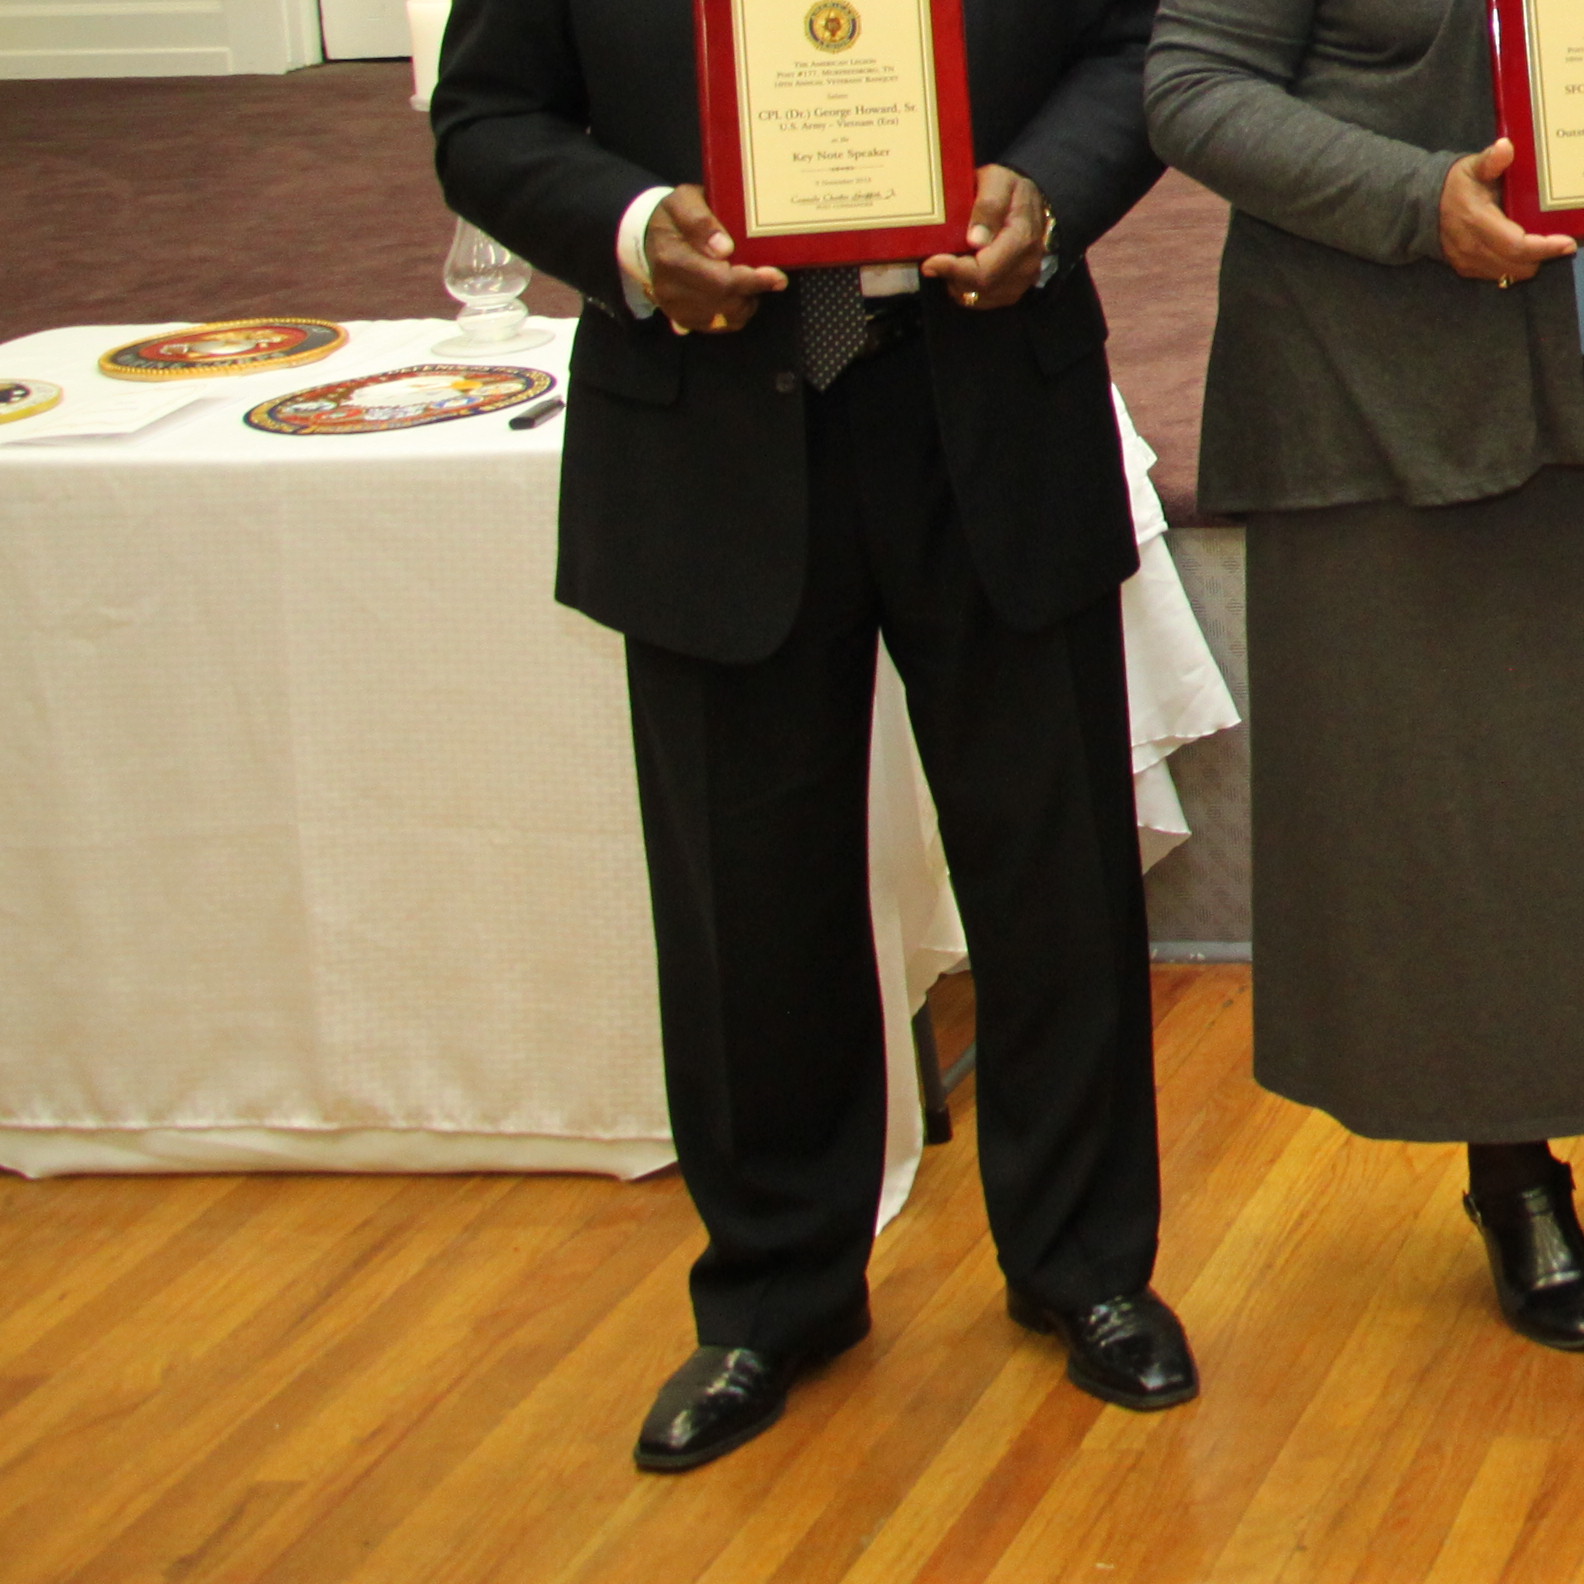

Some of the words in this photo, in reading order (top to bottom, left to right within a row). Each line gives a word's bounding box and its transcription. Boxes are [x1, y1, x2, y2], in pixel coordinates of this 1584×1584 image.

[1564, 85, 1584, 94] SFC
[758, 111, 782, 121] CPL
[785, 109, 810, 120] (Dr.)
[814, 107, 851, 118] George
[855, 103, 900, 114] Howard,
[836, 119, 874, 128] Vietnam
[793, 151, 813, 162] Key
[817, 150, 844, 159] Note
[848, 148, 890, 161] Speaker
